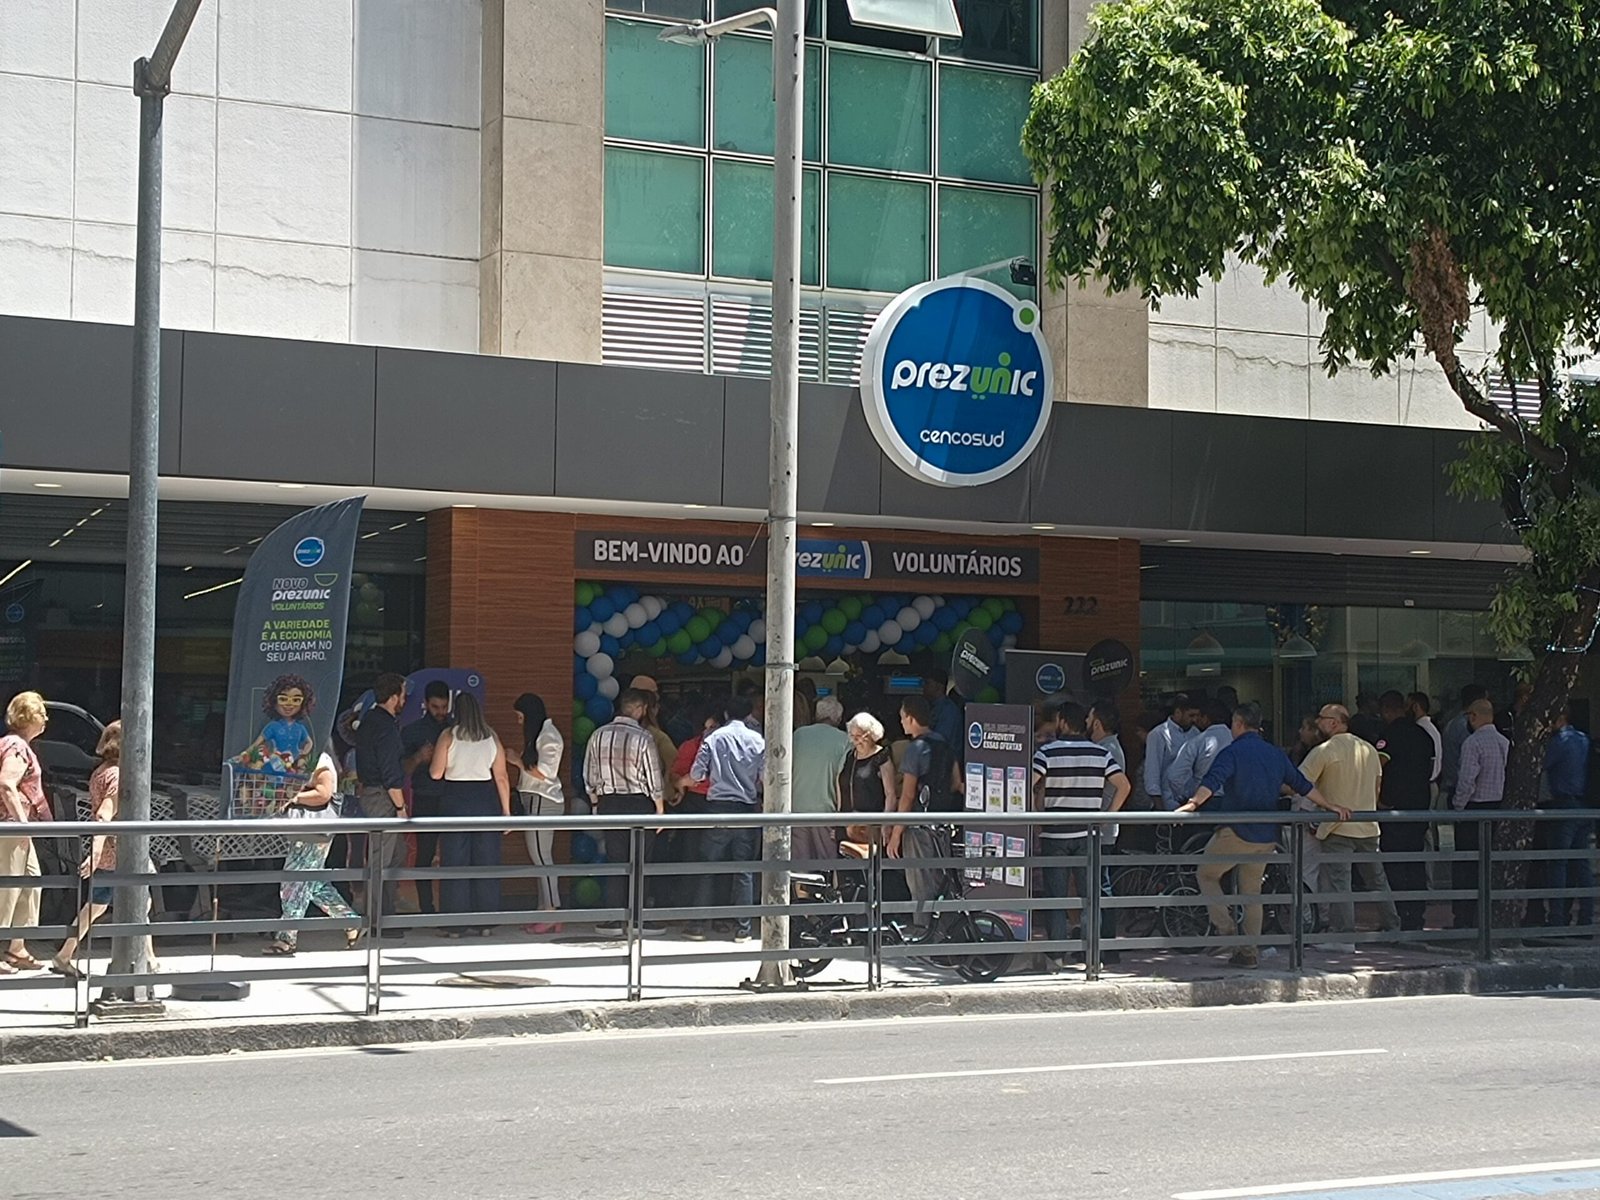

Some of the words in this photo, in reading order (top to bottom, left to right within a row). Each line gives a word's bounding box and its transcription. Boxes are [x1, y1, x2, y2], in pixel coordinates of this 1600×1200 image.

[890, 352, 1037, 399] prezunic
[920, 429, 1006, 448] cencosud
[594, 539, 712, 565] BEM-VINDO
[716, 545, 744, 566] AO
[795, 545, 862, 572] ezunic
[892, 550, 1022, 577] VOLUNTÁRIOS
[272, 577, 309, 590] NOVO
[272, 588, 331, 601] prezunic
[271, 601, 325, 611] VOLUNTÁRIOS
[1064, 596, 1098, 616] 222
[263, 621, 271, 630] A
[273, 619, 330, 630] VARIEDADE
[262, 631, 268, 640] E
[270, 631, 278, 640] A
[280, 630, 332, 640] ECONOMIA
[260, 641, 317, 652] CHEGARAM
[318, 640, 332, 650] NO
[266, 652, 287, 662] SEU
